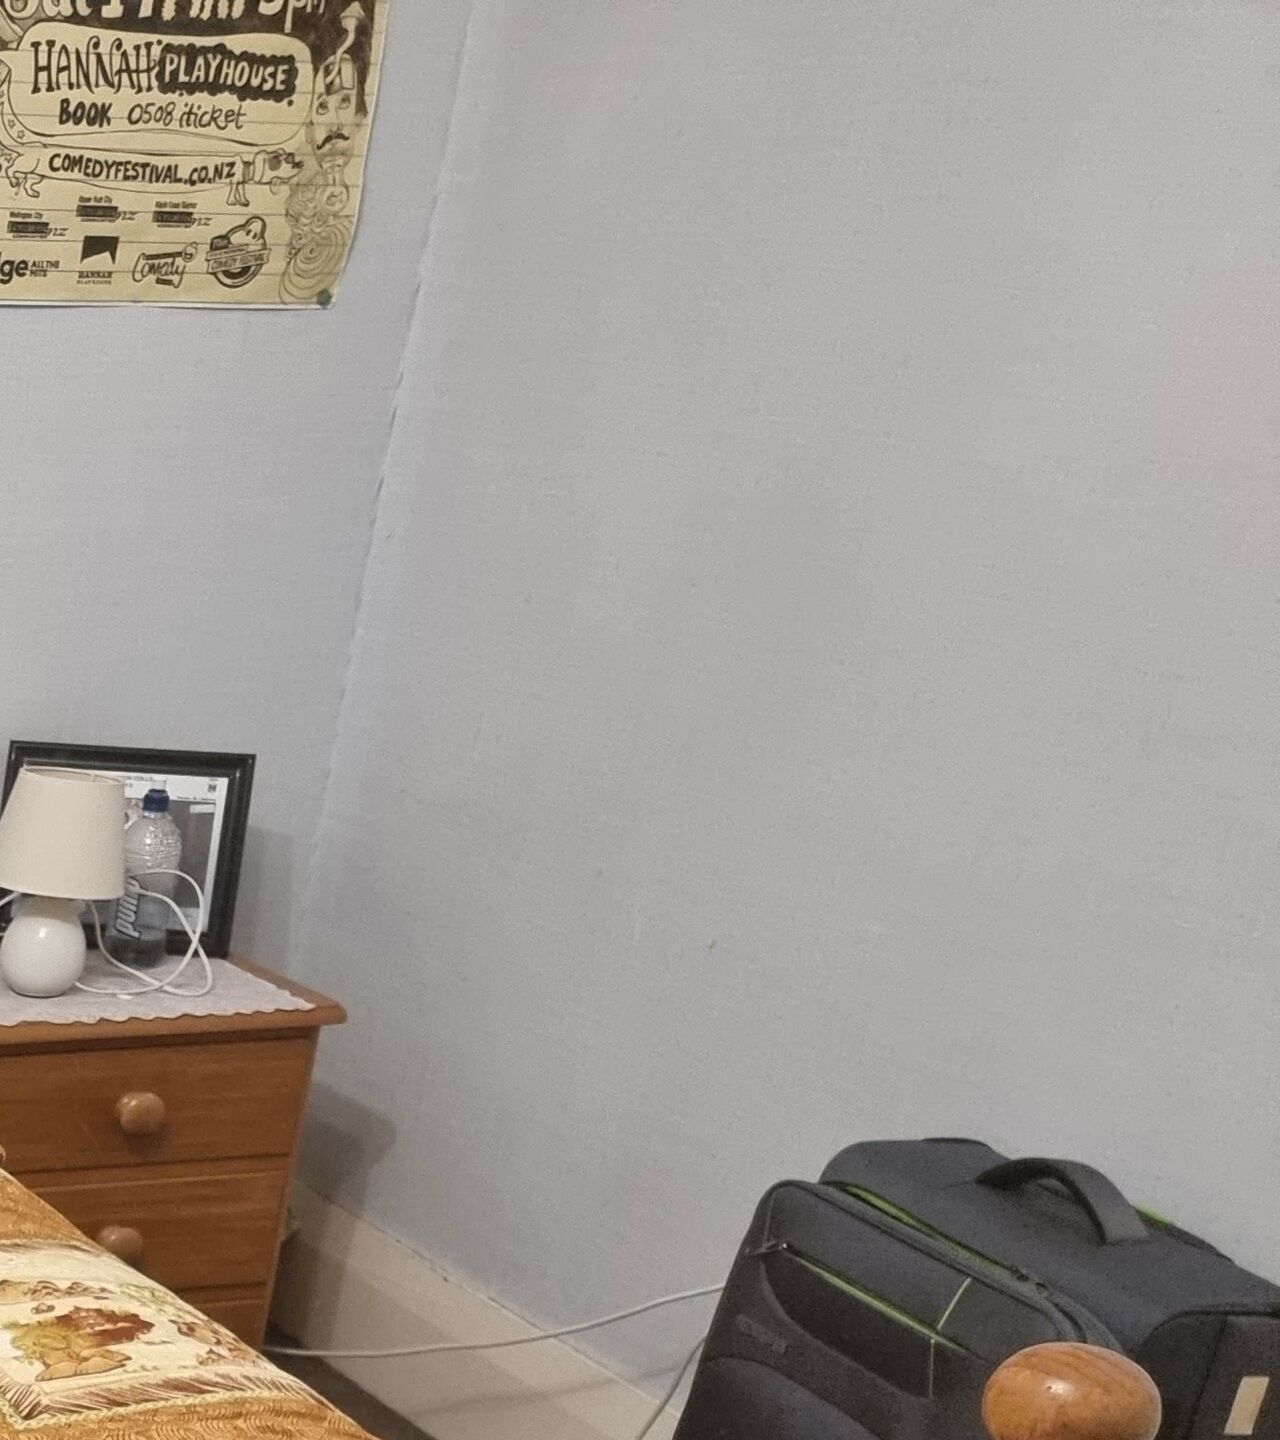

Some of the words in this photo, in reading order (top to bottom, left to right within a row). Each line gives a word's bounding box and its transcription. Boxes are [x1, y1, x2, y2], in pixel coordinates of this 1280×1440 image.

[30, 35, 158, 95] HANNAH
[165, 53, 290, 91] PLAYHOUSE
[58, 98, 112, 128] BOOK
[128, 101, 177, 127] 0508
[47, 153, 237, 187] COMEDYFESTIVAL.CO.NZ
